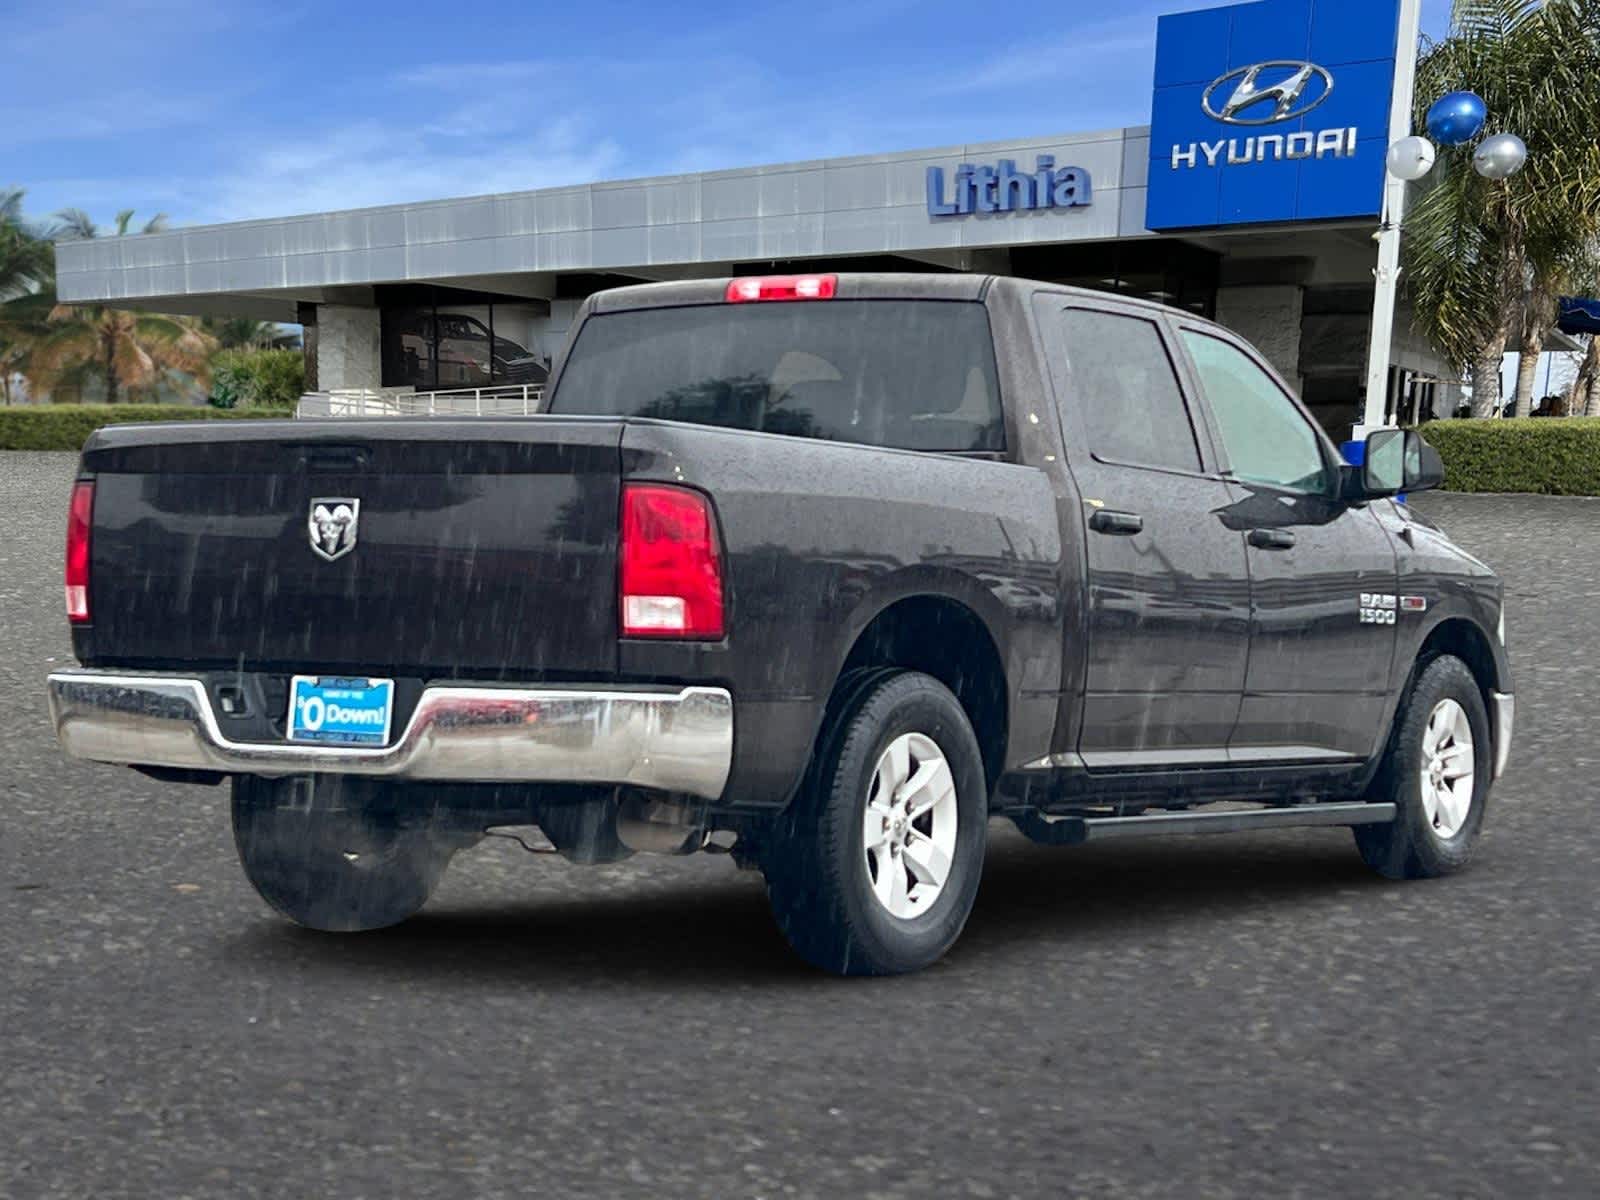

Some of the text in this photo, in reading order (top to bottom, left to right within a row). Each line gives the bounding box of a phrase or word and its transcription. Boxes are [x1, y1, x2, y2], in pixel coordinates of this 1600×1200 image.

[1171, 127, 1358, 169] HYUNDAI
[926, 152, 1093, 216] Lithia
[1360, 609, 1395, 625] 1500
[327, 704, 384, 725] Down!
